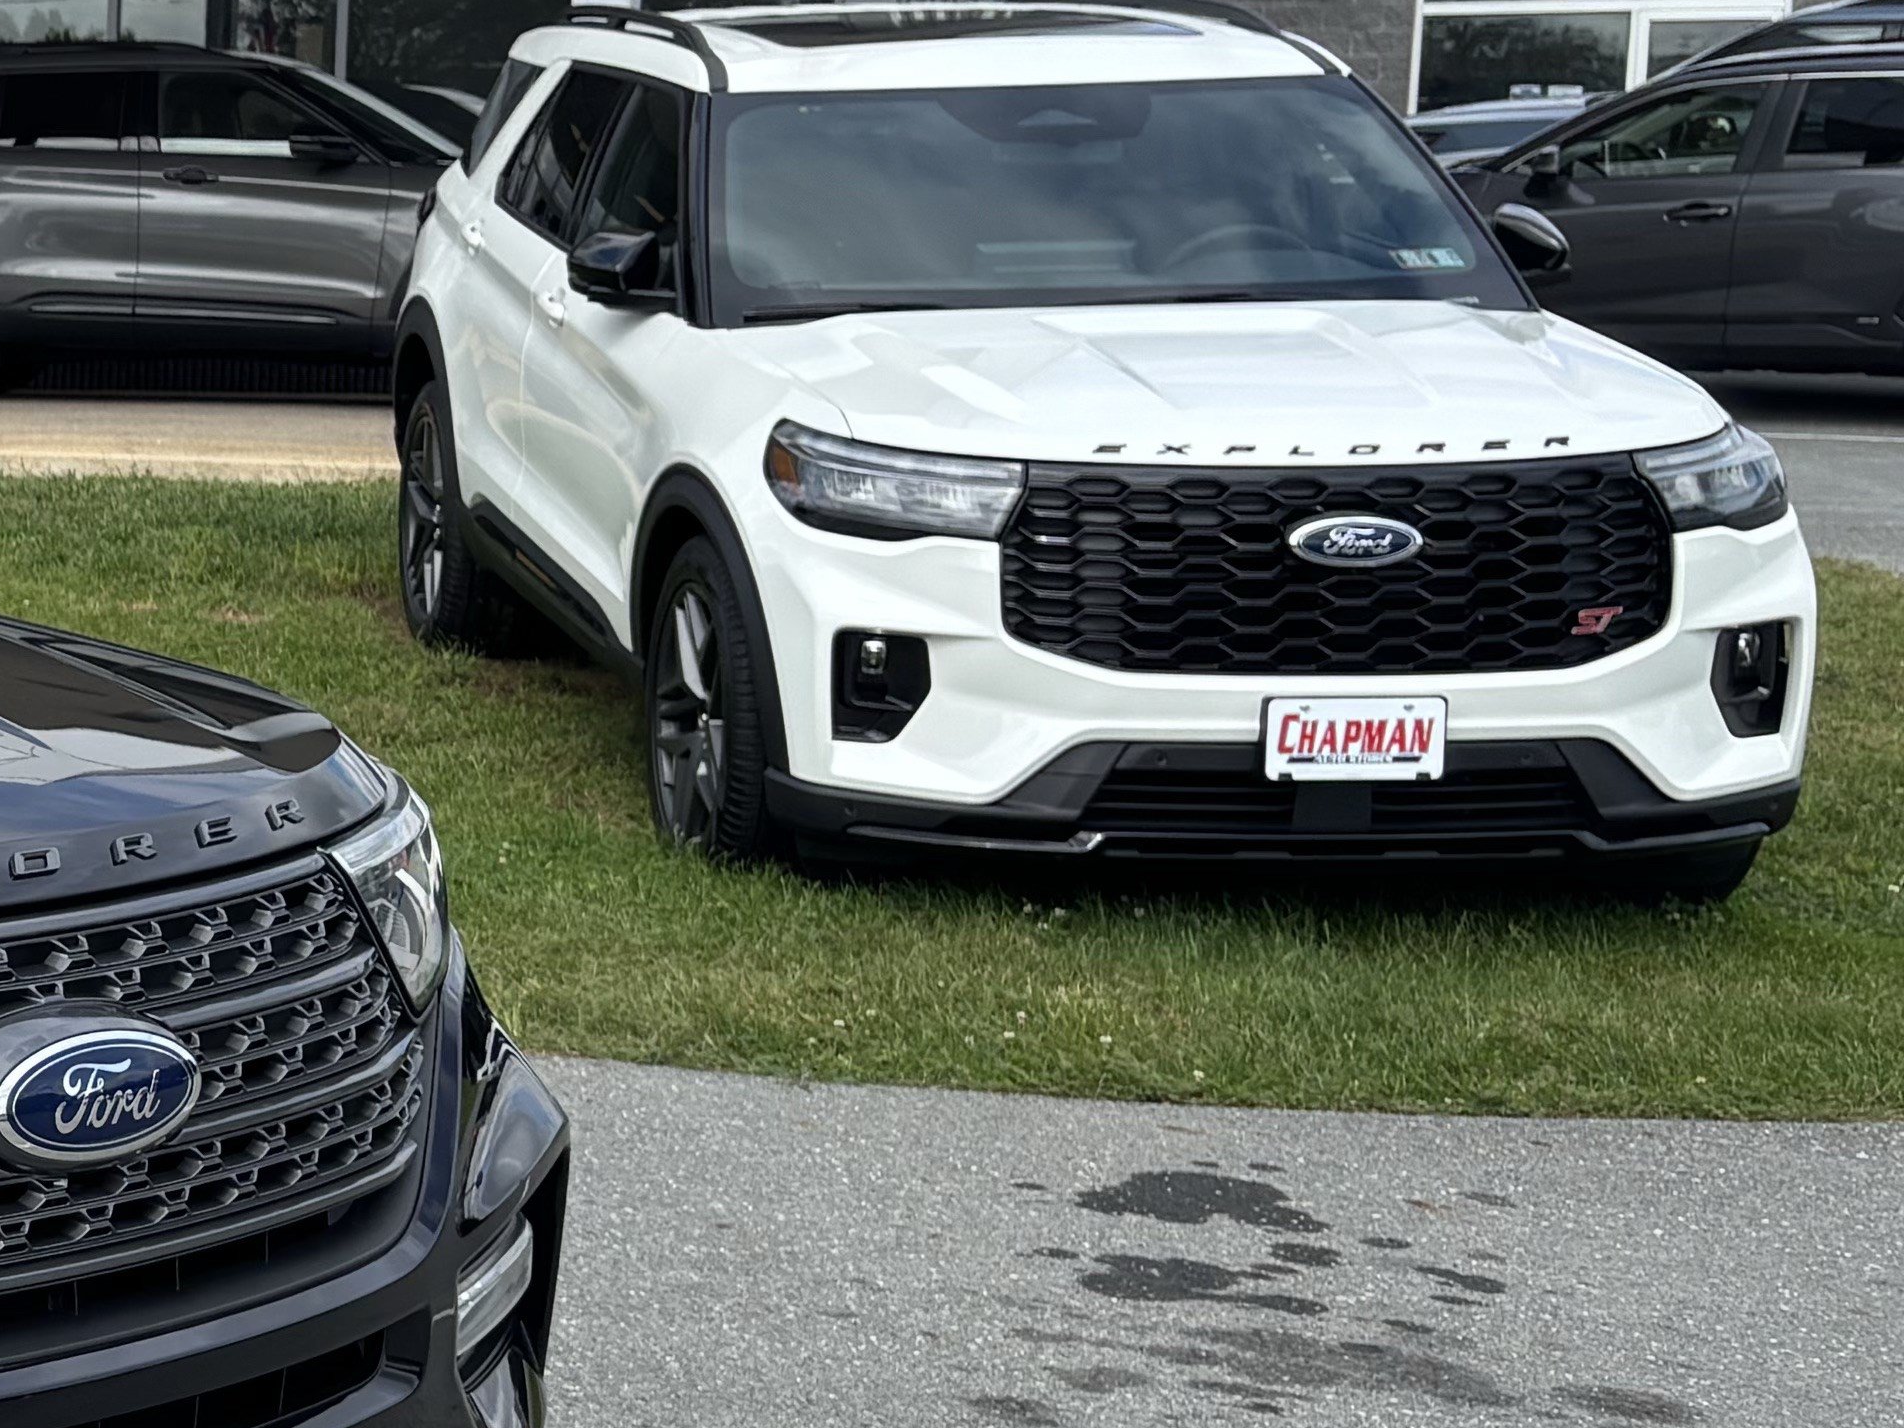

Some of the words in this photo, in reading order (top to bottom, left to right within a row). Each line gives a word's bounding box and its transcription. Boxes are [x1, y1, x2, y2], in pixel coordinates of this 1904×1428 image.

[1093, 435, 1571, 457] EXPLORER
[1323, 526, 1392, 555] Ford
[1571, 605, 1624, 636] ST
[1277, 713, 1435, 754] CHAPMAN
[55, 1058, 161, 1134] Ford
